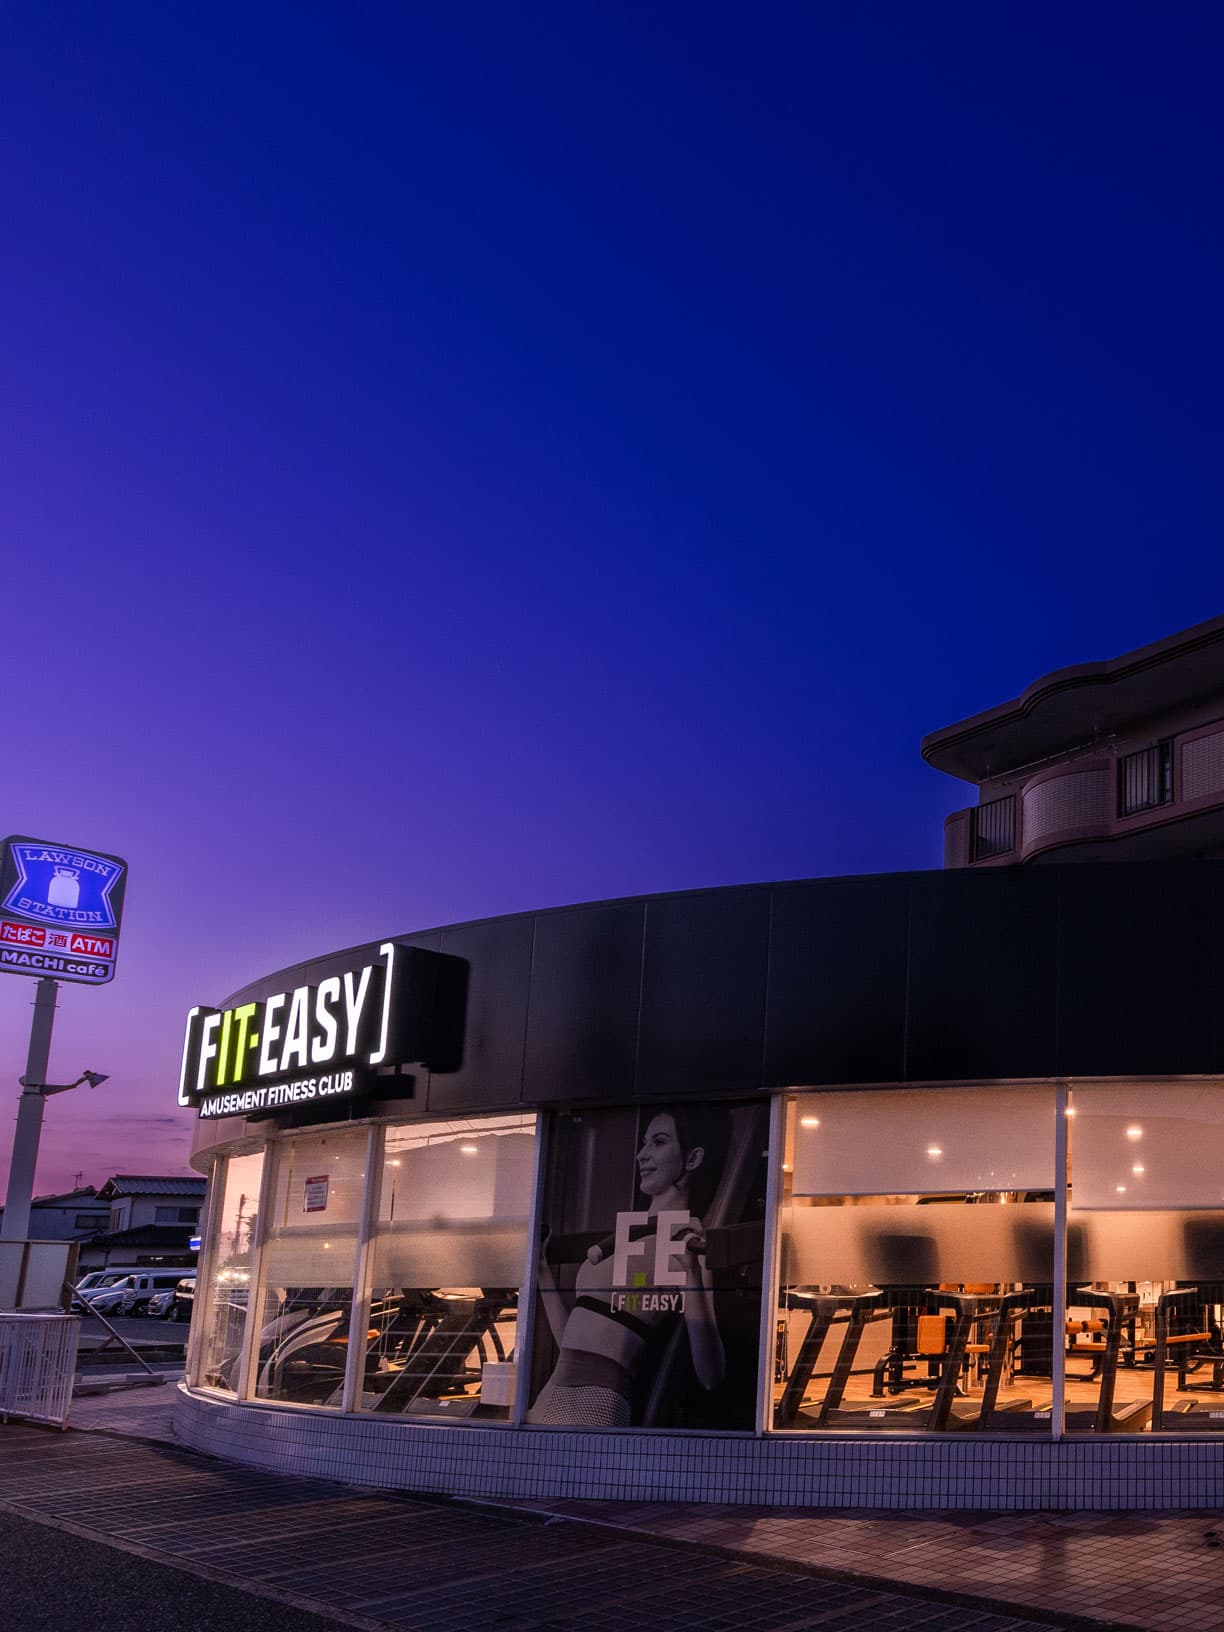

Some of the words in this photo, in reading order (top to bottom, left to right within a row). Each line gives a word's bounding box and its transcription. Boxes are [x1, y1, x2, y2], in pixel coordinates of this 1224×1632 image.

[24, 850, 112, 877] LAWSON
[17, 897, 104, 922] STATION
[2, 925, 44, 945] たばこ
[48, 933, 68, 948] 酒
[71, 937, 111, 955] ATM
[1, 950, 64, 970] MACHI
[66, 964, 105, 977] café
[200, 1087, 268, 1118] AMUSEMENT
[267, 1080, 316, 1105] FITNESS
[318, 1071, 353, 1095] CLUB
